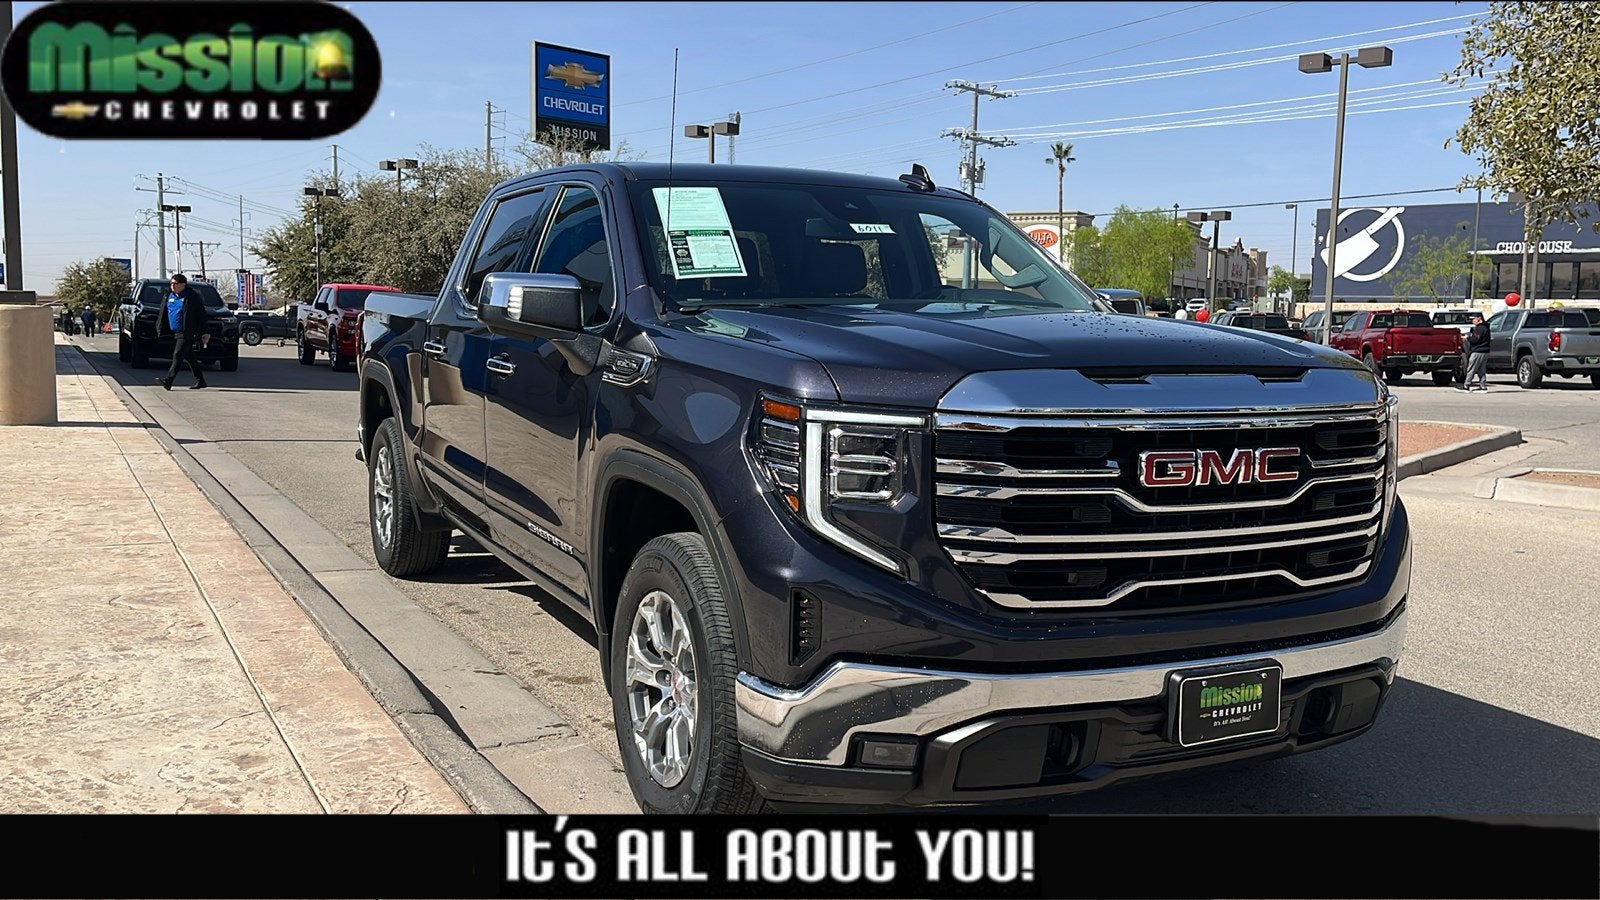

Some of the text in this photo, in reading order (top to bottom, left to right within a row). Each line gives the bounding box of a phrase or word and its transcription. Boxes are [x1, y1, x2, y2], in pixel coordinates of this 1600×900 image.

[543, 96, 605, 115] CHEVROLET
[553, 125, 597, 141] MISSION
[1029, 232, 1053, 242] ULTA
[1139, 447, 1300, 487] GMC
[527, 521, 574, 555] SIERRA
[1212, 702, 1262, 718] CHEVROLET
